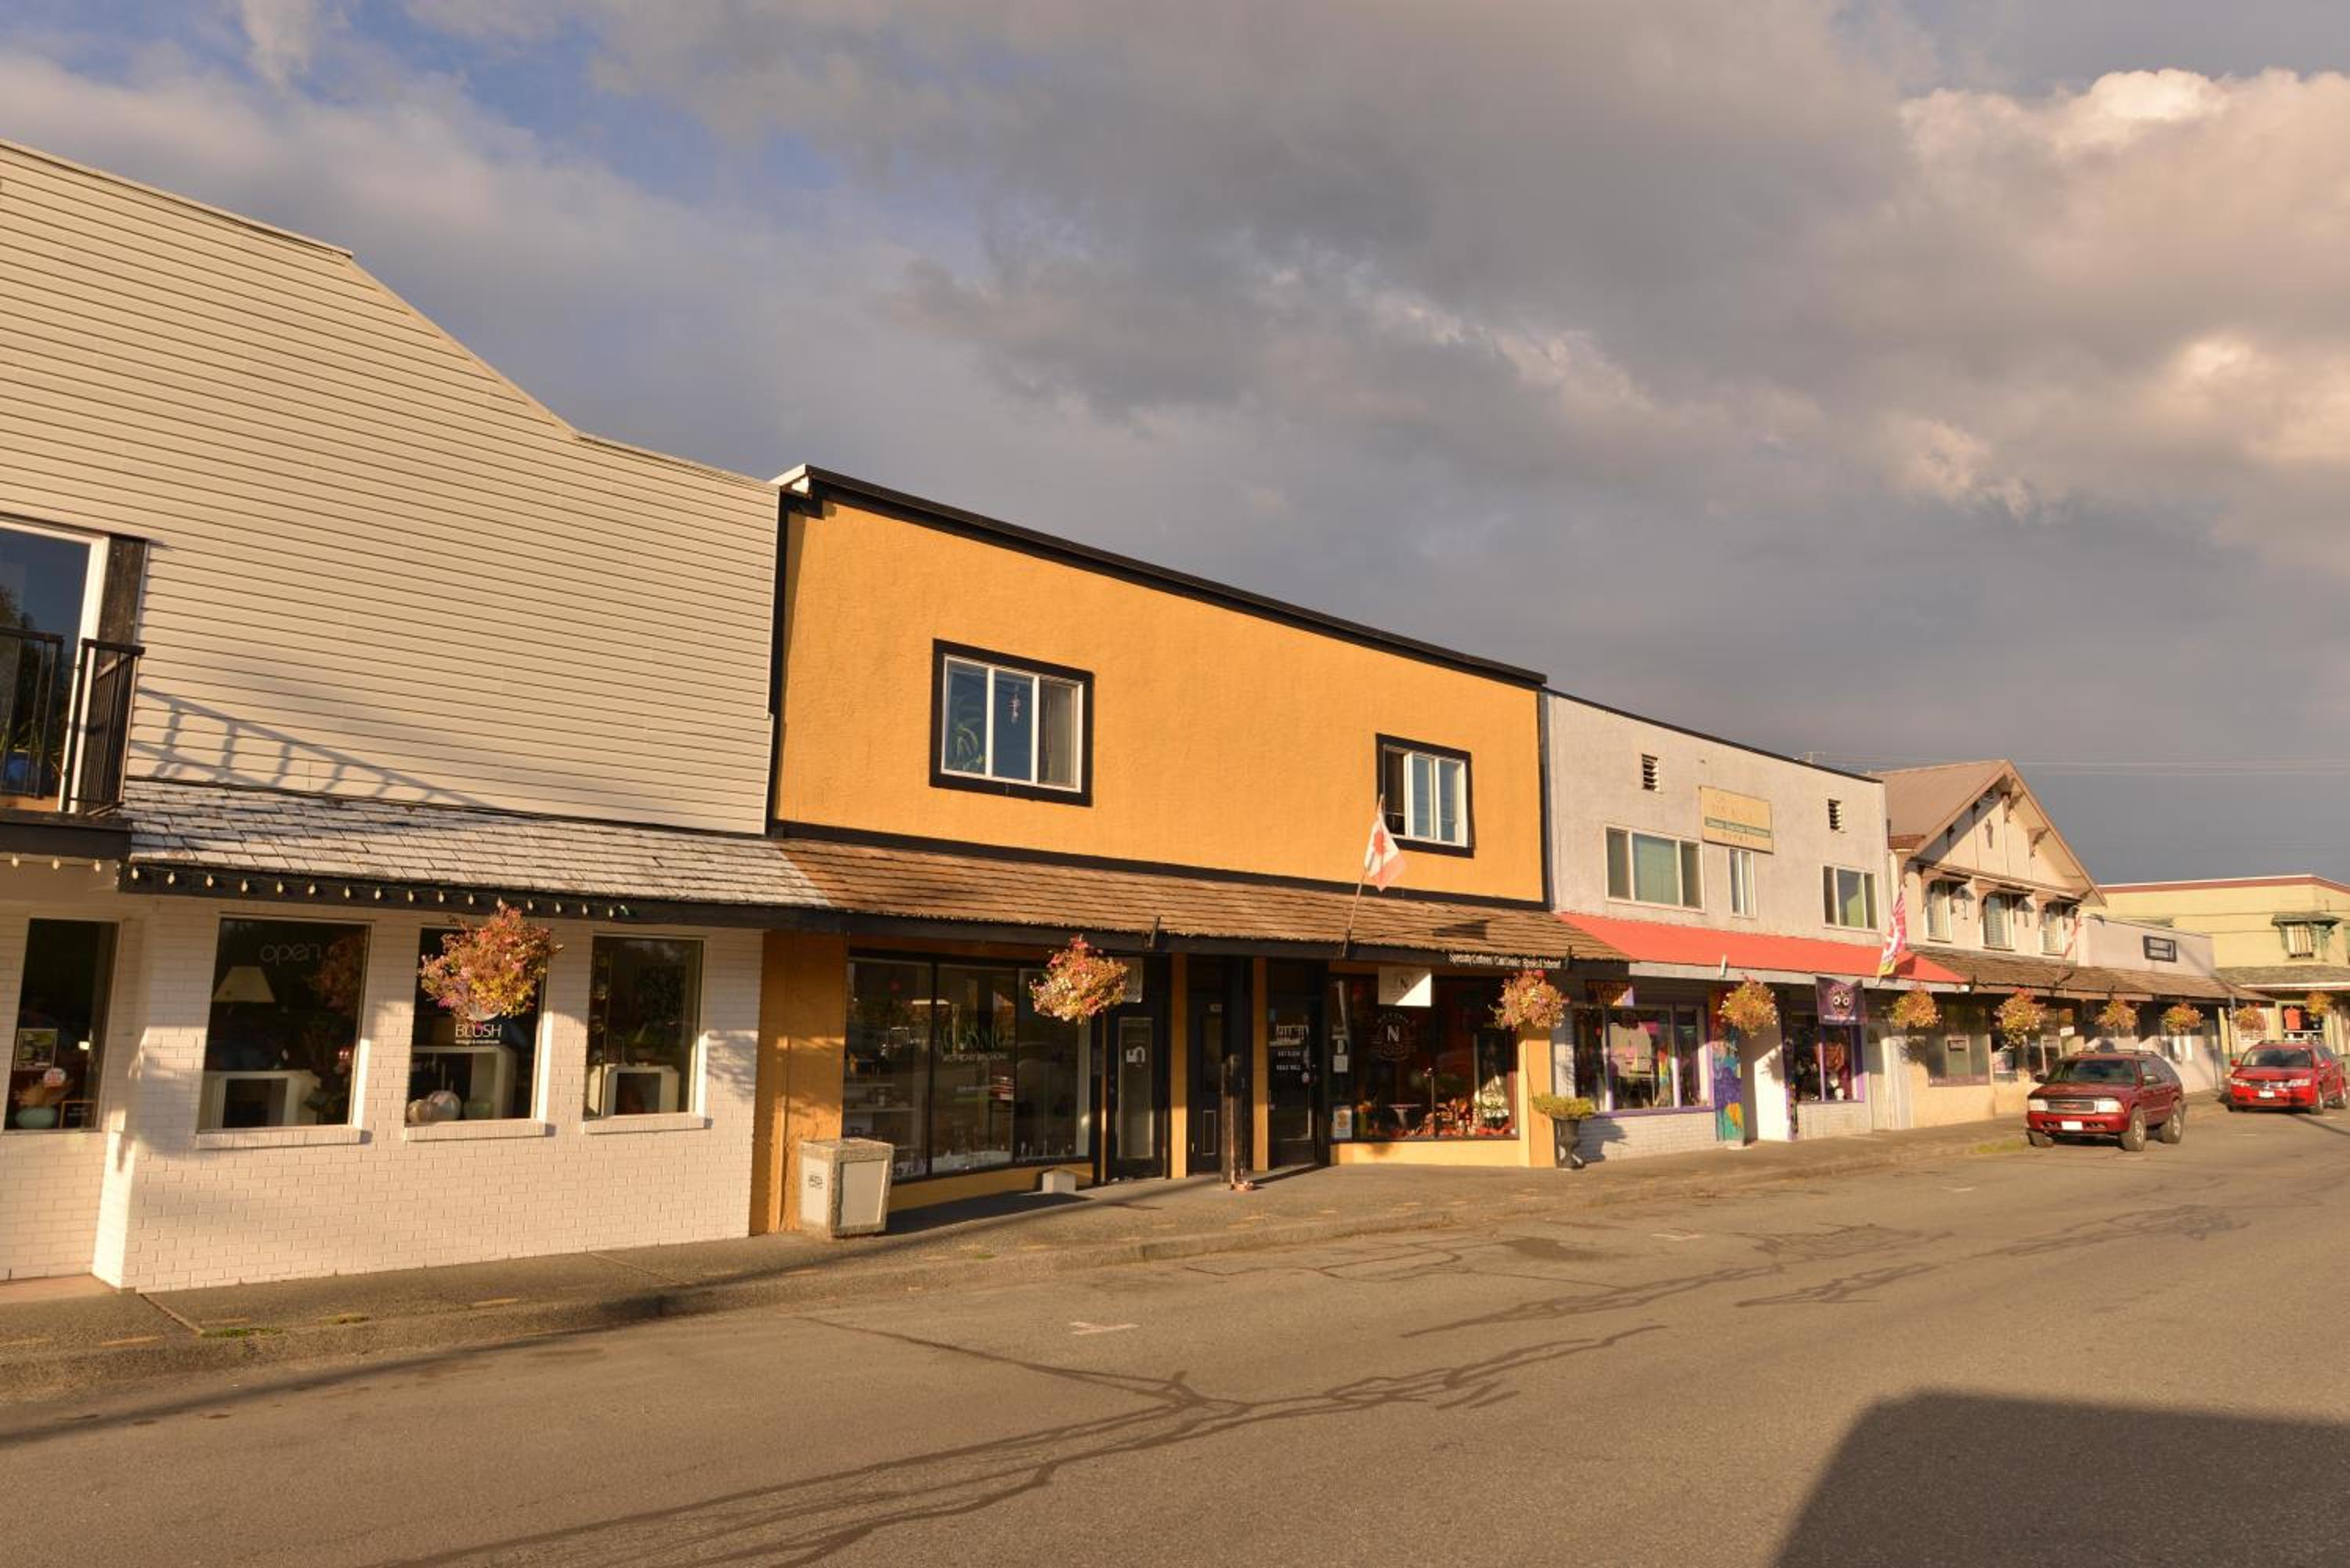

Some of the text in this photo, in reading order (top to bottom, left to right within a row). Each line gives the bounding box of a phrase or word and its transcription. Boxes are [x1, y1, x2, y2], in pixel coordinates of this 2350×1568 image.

[259, 942, 320, 965] open
[455, 1024, 502, 1038] BLUSH
[1386, 1024, 1400, 1042] N
